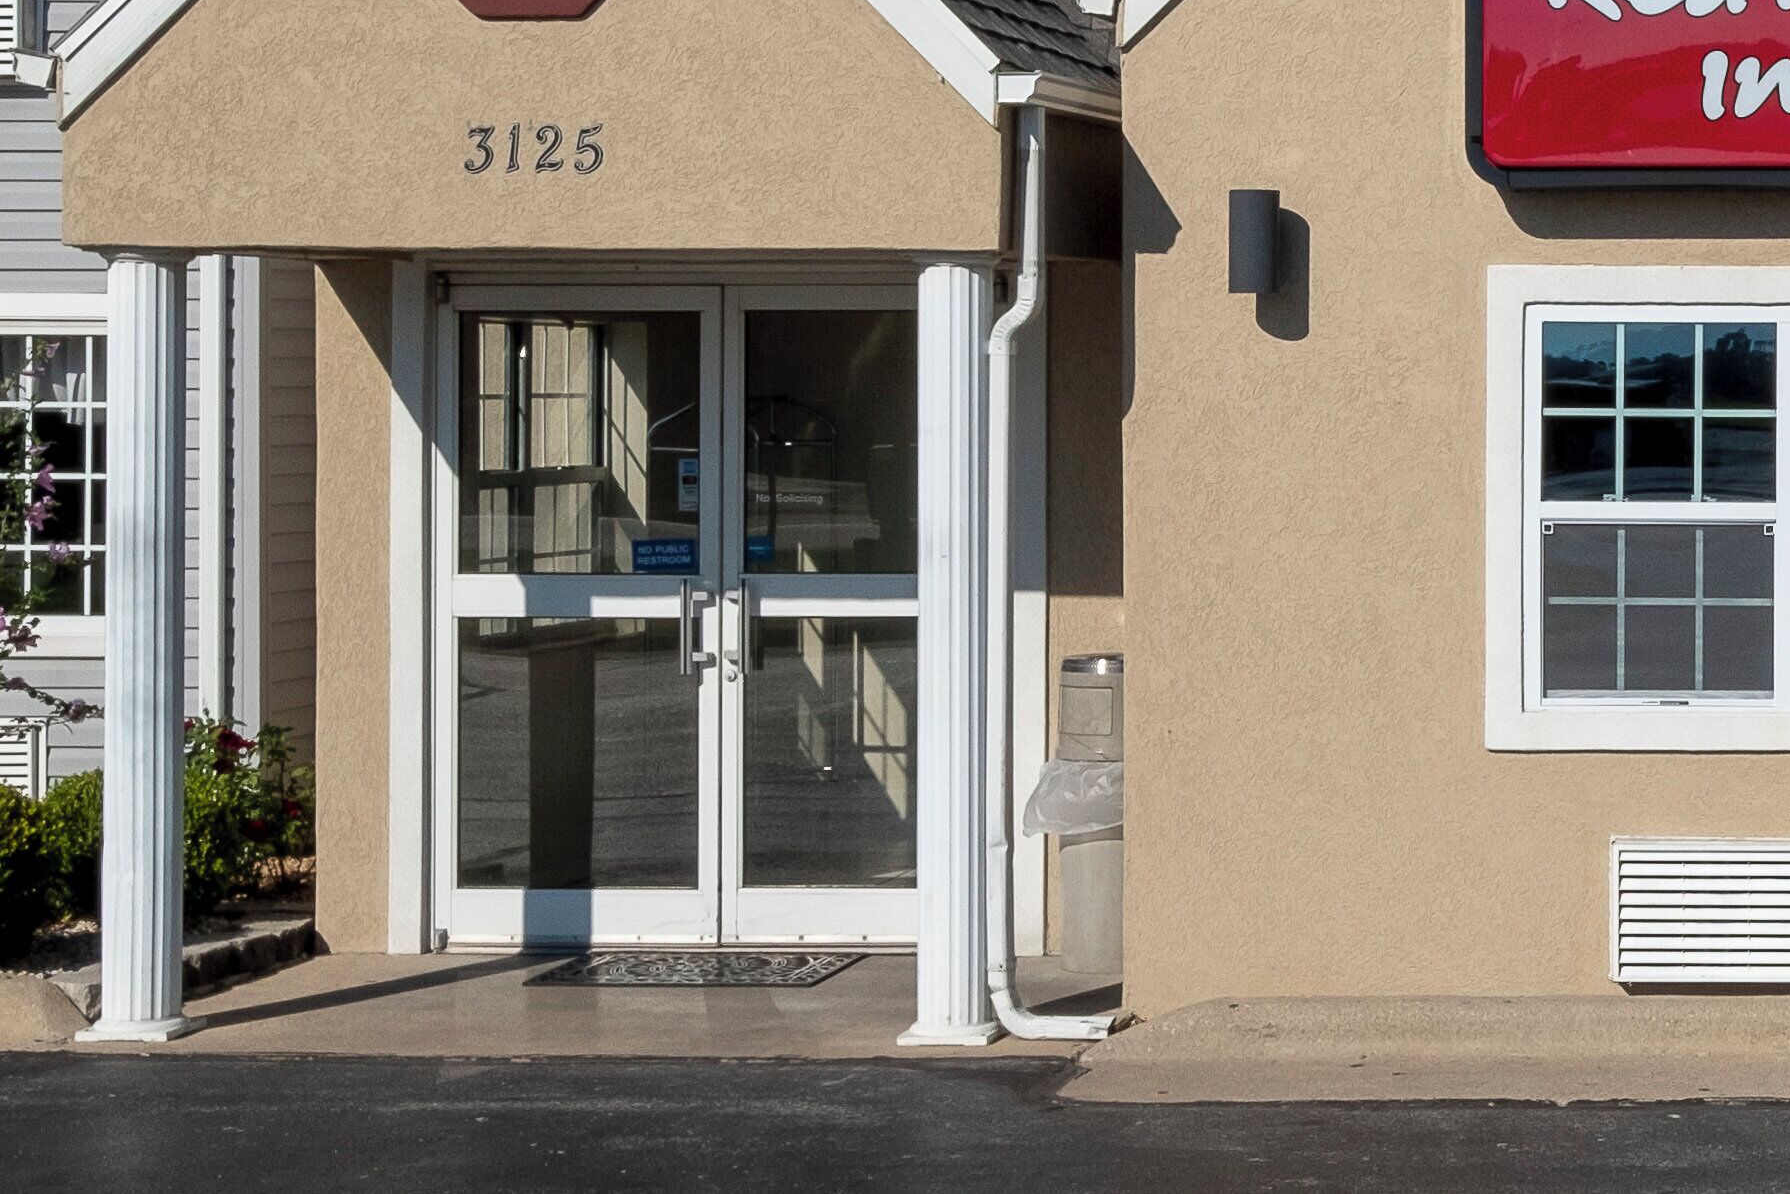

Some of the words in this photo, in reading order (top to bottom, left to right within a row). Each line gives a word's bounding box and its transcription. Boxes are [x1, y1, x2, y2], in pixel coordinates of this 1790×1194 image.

[464, 122, 604, 174] 3125
[638, 545, 653, 554] NO
[655, 545, 689, 554] PUBLIC
[637, 556, 691, 565] RESTROOM
